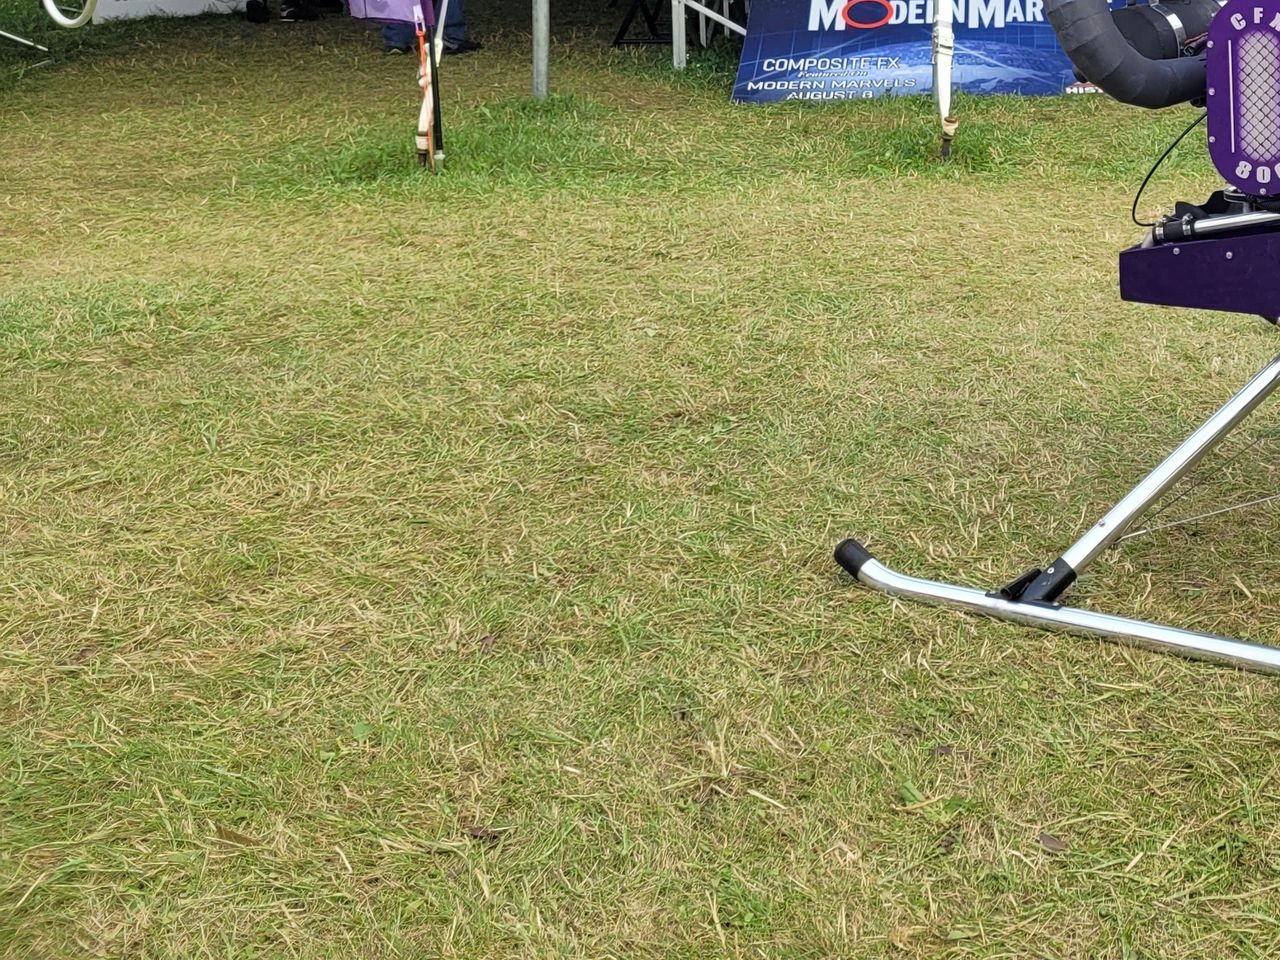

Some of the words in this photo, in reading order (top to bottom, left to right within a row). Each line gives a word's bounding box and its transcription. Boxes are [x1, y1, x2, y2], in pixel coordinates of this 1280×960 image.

[763, 56, 900, 72] COMPOSITE-FX
[796, 70, 848, 79] Featured
[747, 80, 825, 91] MODERN
[831, 78, 917, 89] MARVELS
[786, 90, 858, 101] AUGUST
